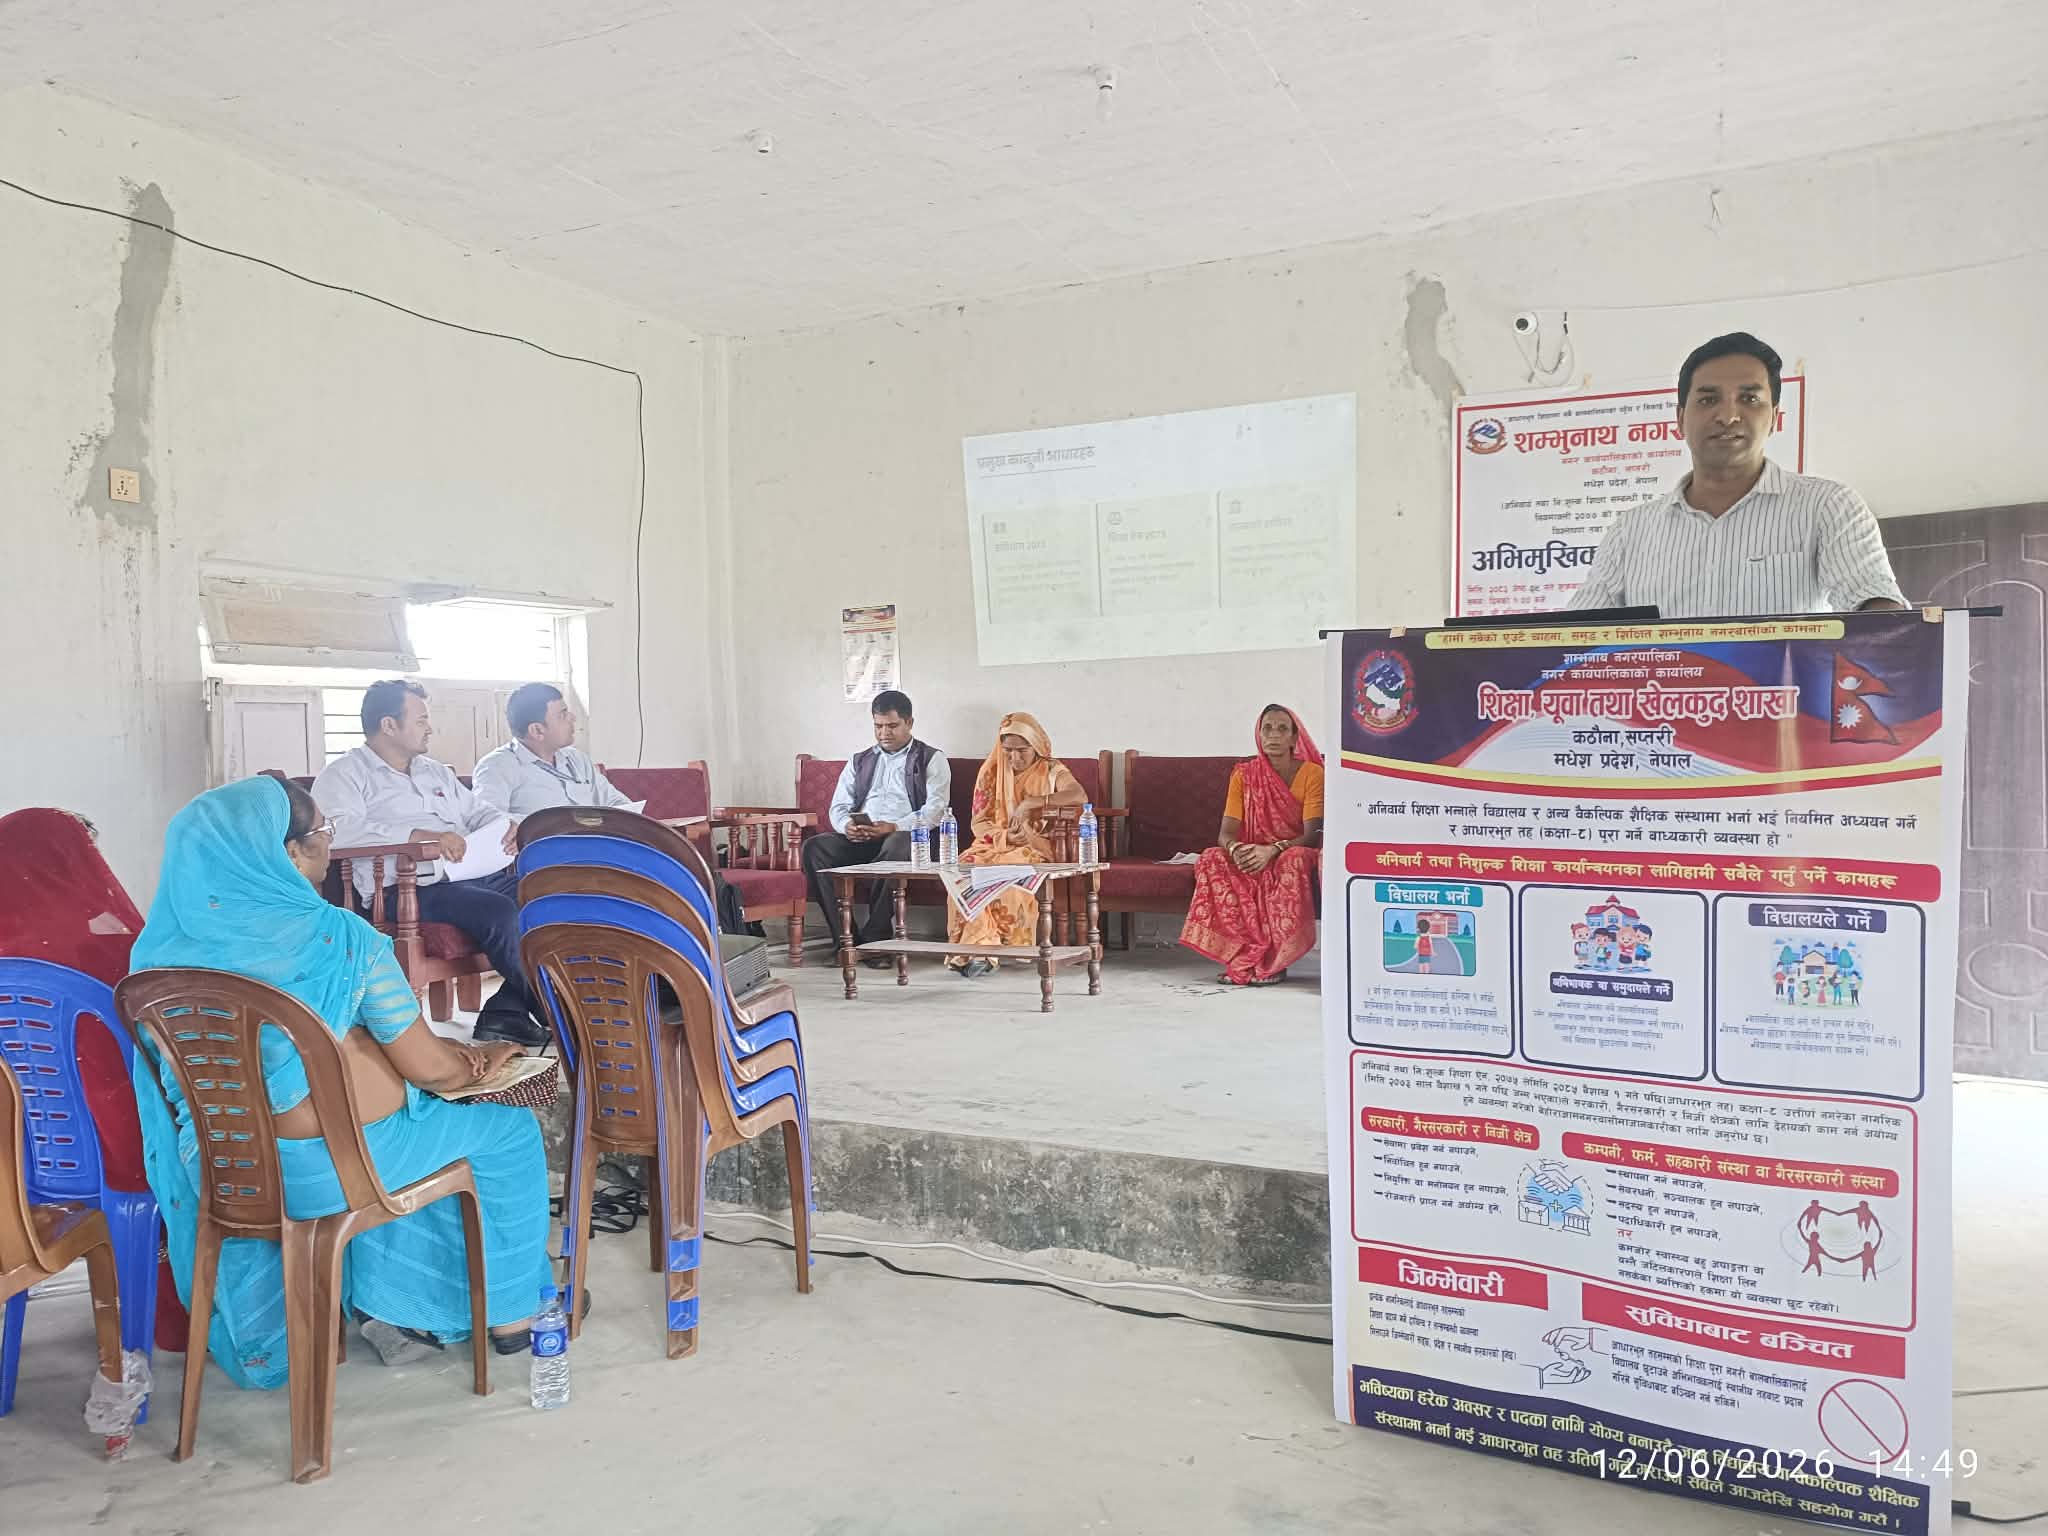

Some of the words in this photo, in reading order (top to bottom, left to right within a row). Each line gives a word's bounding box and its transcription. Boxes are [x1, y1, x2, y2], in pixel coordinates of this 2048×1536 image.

[1514, 424, 1620, 455] शम्भुनाथ
[1541, 667, 1568, 680] नगर
[1588, 688, 1634, 721] तथा
[1733, 687, 1798, 721] शाखा
[1555, 750, 1593, 769] मधेश
[1650, 751, 1692, 769] नेपाल
[1411, 801, 1440, 816] शिक्षा
[1483, 803, 1527, 818] विद्यालय
[1531, 808, 1541, 820] र
[1546, 808, 1571, 819] अन्य
[1575, 805, 1624, 821] वैकल्पिक
[1629, 806, 1670, 822] शैक्षिक
[1784, 809, 1834, 825] नियमित
[1841, 815, 1890, 828] अध्ययन
[1449, 825, 1458, 836] र
[1517, 827, 1535, 839] तह
[1714, 833, 1761, 845] व्यवस्था
[1376, 851, 1422, 867] अनिवार्य
[1428, 856, 1454, 868] तथा
[1512, 856, 1546, 872] शिक्षा
[1387, 884, 1439, 904] विद्यालय
[1445, 886, 1470, 905] भर्ना
[1763, 904, 1839, 930] विद्यालयले
[1472, 1125, 1480, 1138] र
[1664, 1148, 1714, 1173] सहकारी
[1754, 1156, 1772, 1178] वा
[1617, 1228, 1632, 1241] तर
[1397, 1257, 1505, 1298] जिम्मेवारी
[1624, 1302, 1752, 1346] सुविधाबाट
[1417, 1388, 1449, 1409] हरेक
[1452, 1398, 1494, 1420] अवसर
[1496, 1408, 1507, 1423] र
[1510, 1409, 1547, 1430] पदका
[1551, 1414, 1585, 1434] लागि
[1542, 1445, 1564, 1463] तह
